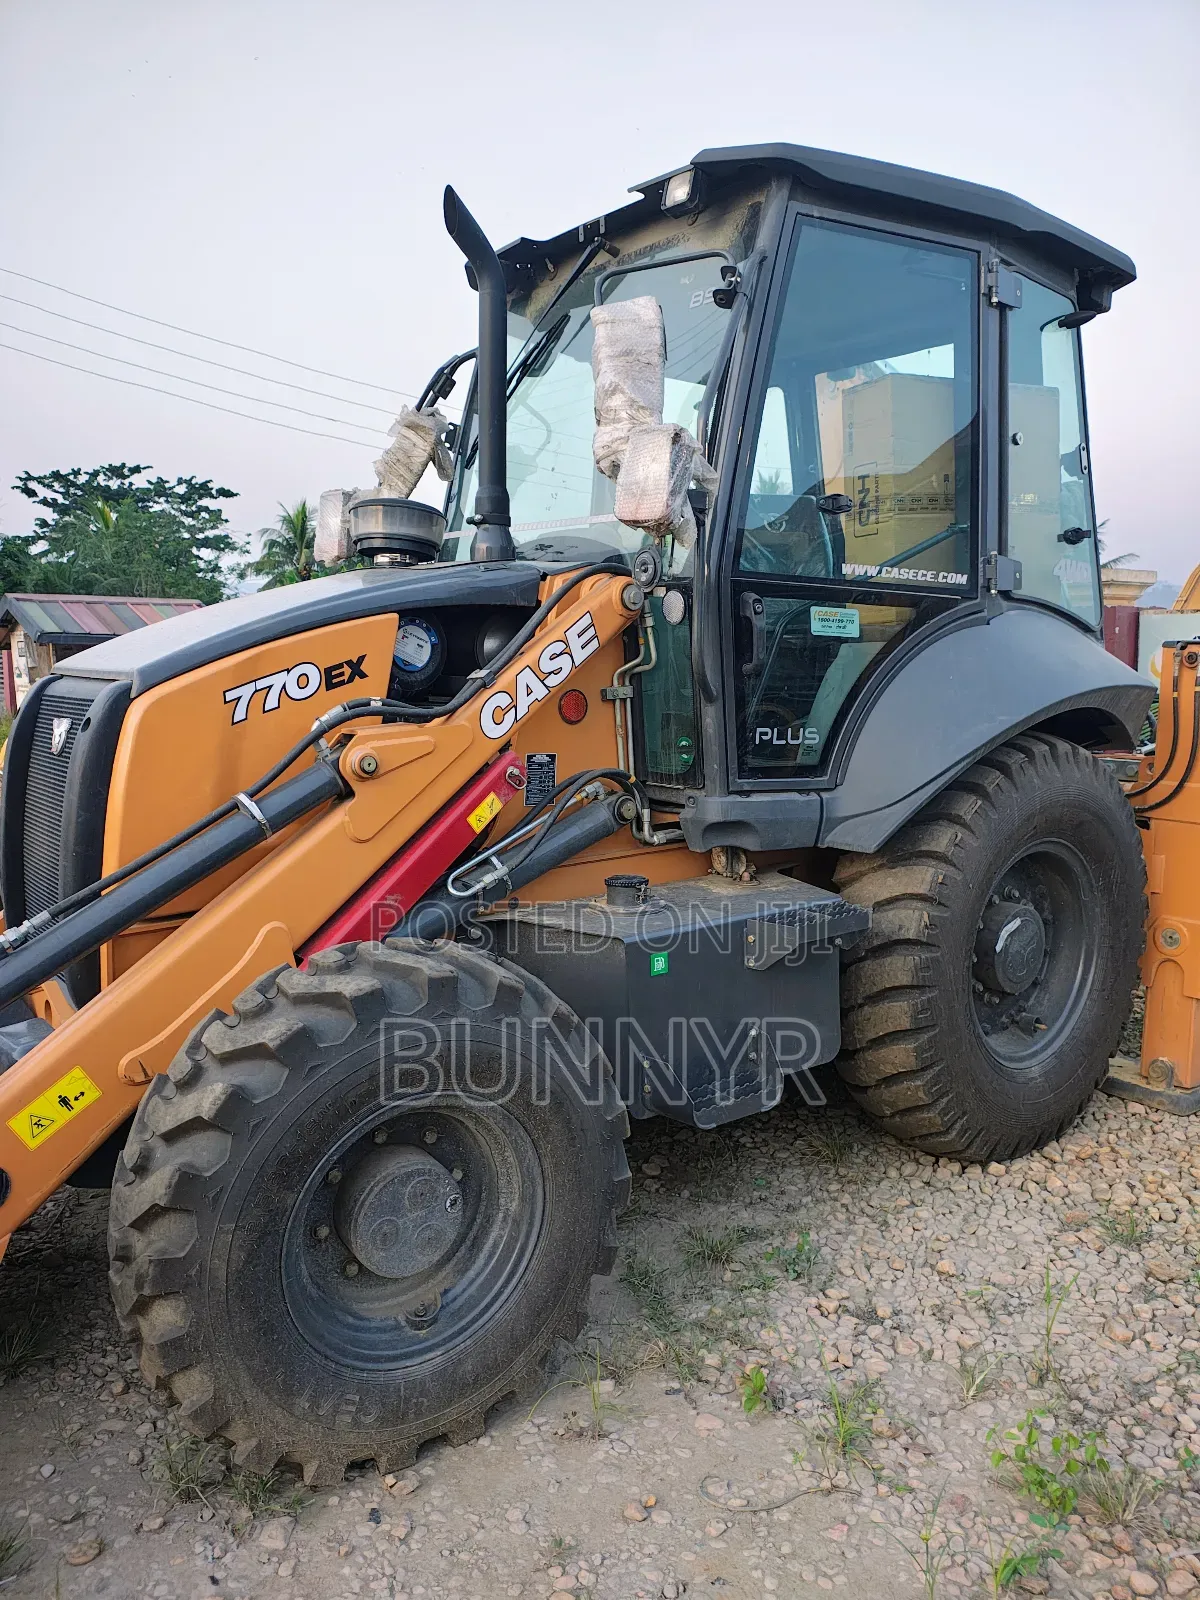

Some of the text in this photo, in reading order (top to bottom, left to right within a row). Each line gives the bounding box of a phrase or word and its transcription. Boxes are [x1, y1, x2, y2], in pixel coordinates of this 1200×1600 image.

[841, 563, 968, 585] WWW.CASECE.COM
[817, 610, 839, 618] CASE
[480, 610, 600, 740] CASE
[223, 654, 369, 726] 770 EX
[755, 727, 820, 745] PLUS
